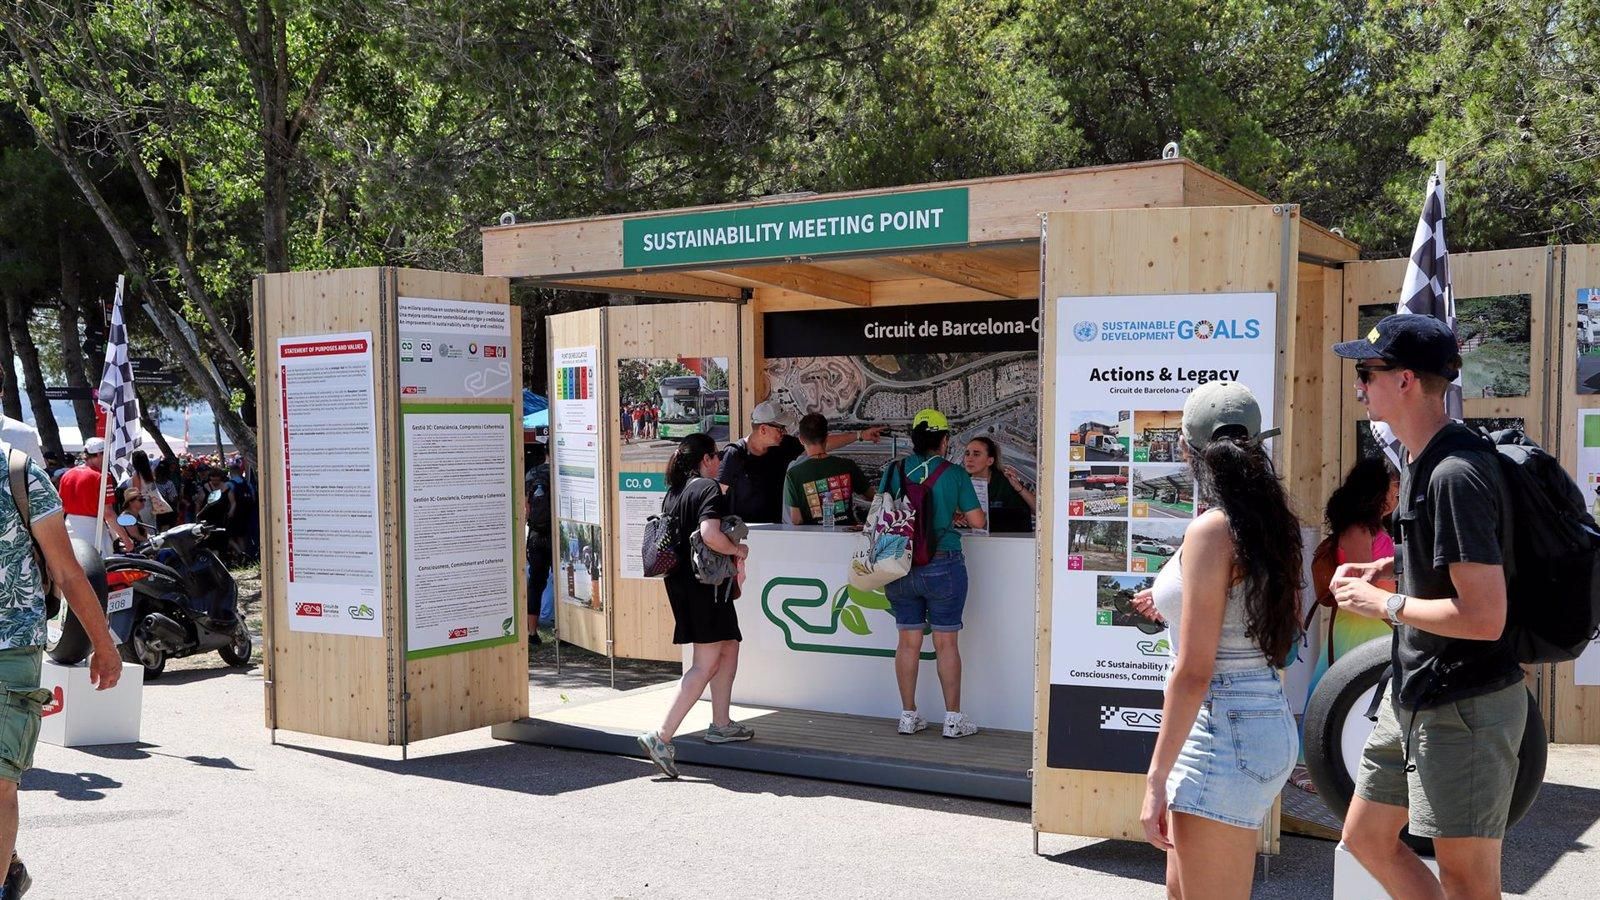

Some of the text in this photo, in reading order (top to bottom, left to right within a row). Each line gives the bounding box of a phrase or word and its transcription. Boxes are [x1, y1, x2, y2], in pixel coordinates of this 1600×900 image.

[643, 208, 944, 252] SUSTAINABILITY MEETING POINT
[864, 320, 915, 339] Circuit
[918, 320, 939, 337] de
[1102, 318, 1260, 340] SUSTAINABLE GOALS
[1101, 331, 1175, 341] DEVELOPMENT
[284, 346, 308, 355] STATEMENT
[314, 344, 337, 353] PURPOSES
[347, 343, 364, 351] VALUES
[1089, 366, 1240, 385] Actions & Legacy
[1109, 386, 1133, 394] Circuit
[1134, 386, 1143, 394] de
[418, 563, 451, 572] Consciousness,
[451, 560, 476, 568] Commitment
[1095, 659, 1106, 668] 3C
[1107, 660, 1163, 672] Sustainability
[1069, 669, 1130, 681] Consciousness,
